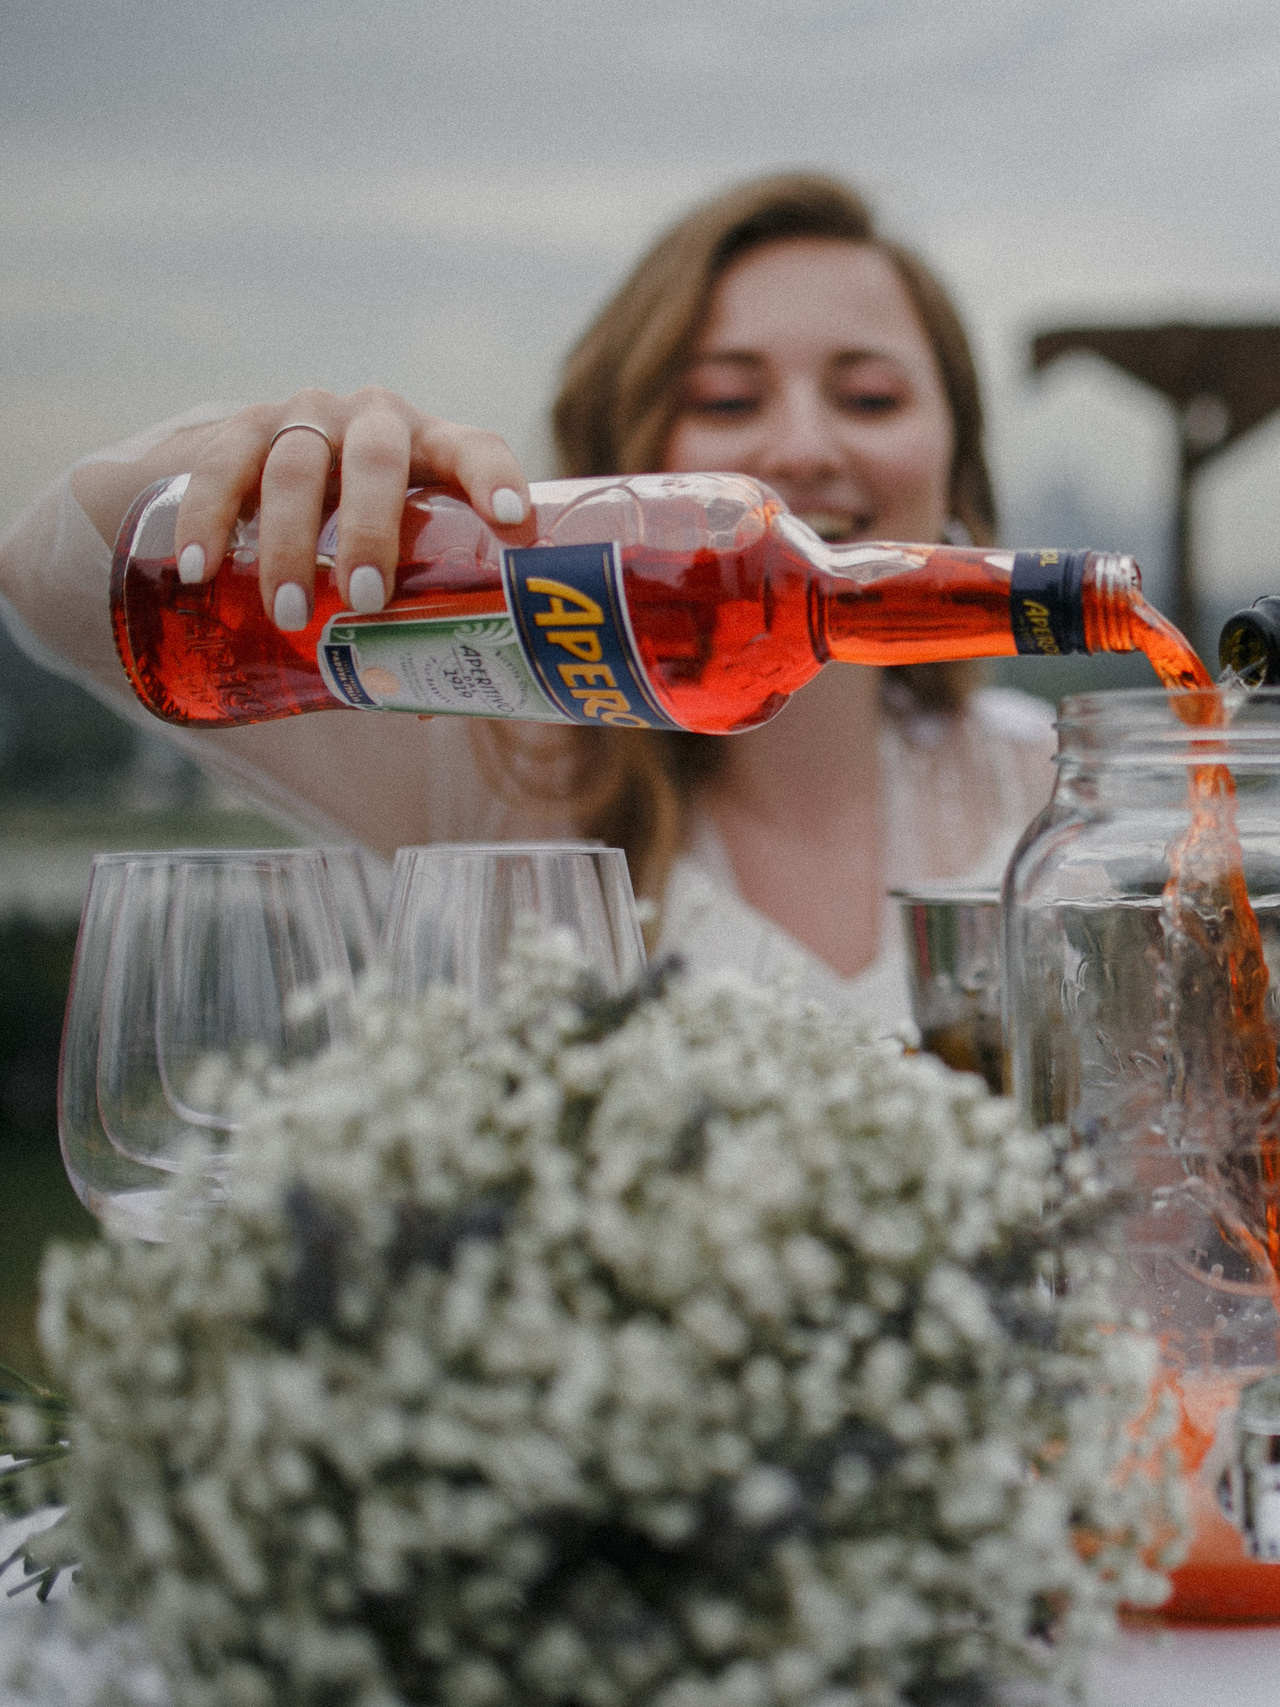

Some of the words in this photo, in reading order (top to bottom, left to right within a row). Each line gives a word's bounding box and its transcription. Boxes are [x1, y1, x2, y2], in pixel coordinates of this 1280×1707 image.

[443, 670, 473, 699] 1919
[460, 645, 515, 713] APERITIVO
[525, 576, 650, 728] APERO
